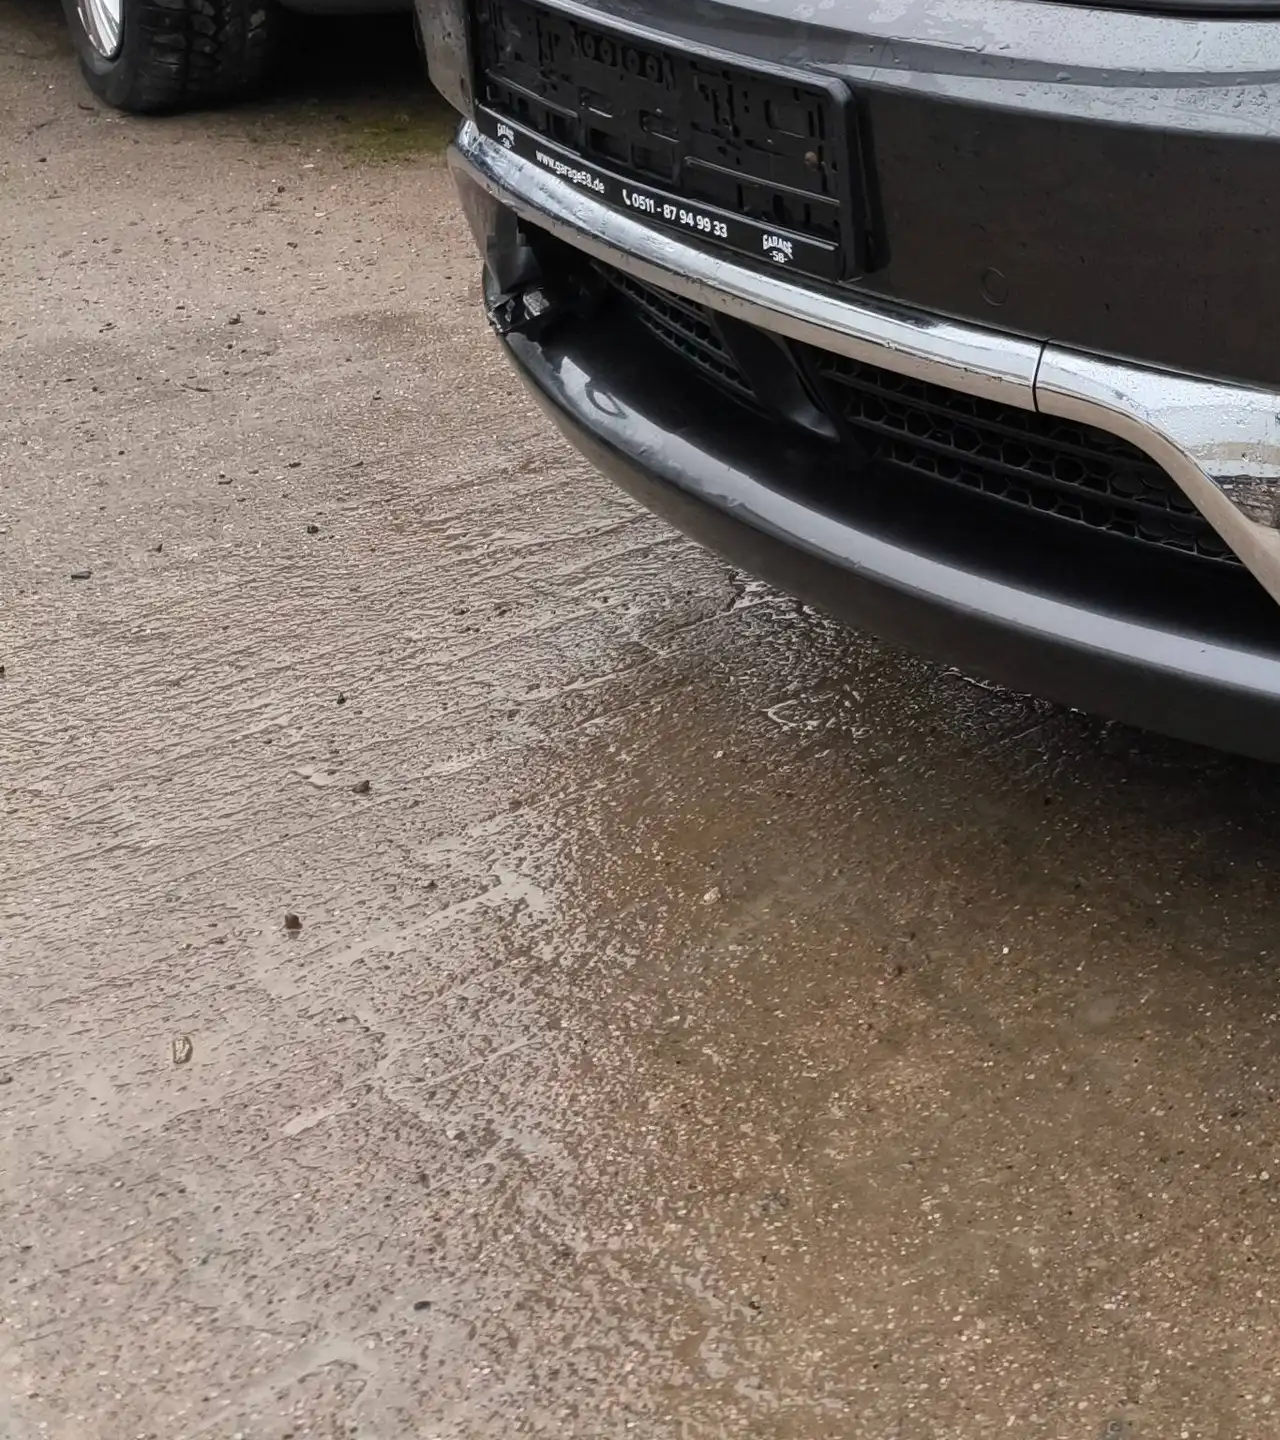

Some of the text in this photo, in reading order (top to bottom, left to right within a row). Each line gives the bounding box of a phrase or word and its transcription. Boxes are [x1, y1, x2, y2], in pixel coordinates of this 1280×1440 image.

[535, 150, 605, 194] www.garage58.de
[632, 193, 656, 213] 0511
[663, 204, 677, 220] 87
[679, 210, 695, 227] 94
[696, 215, 711, 232] 99
[713, 220, 728, 238] 33
[763, 234, 793, 259] GARAGE
